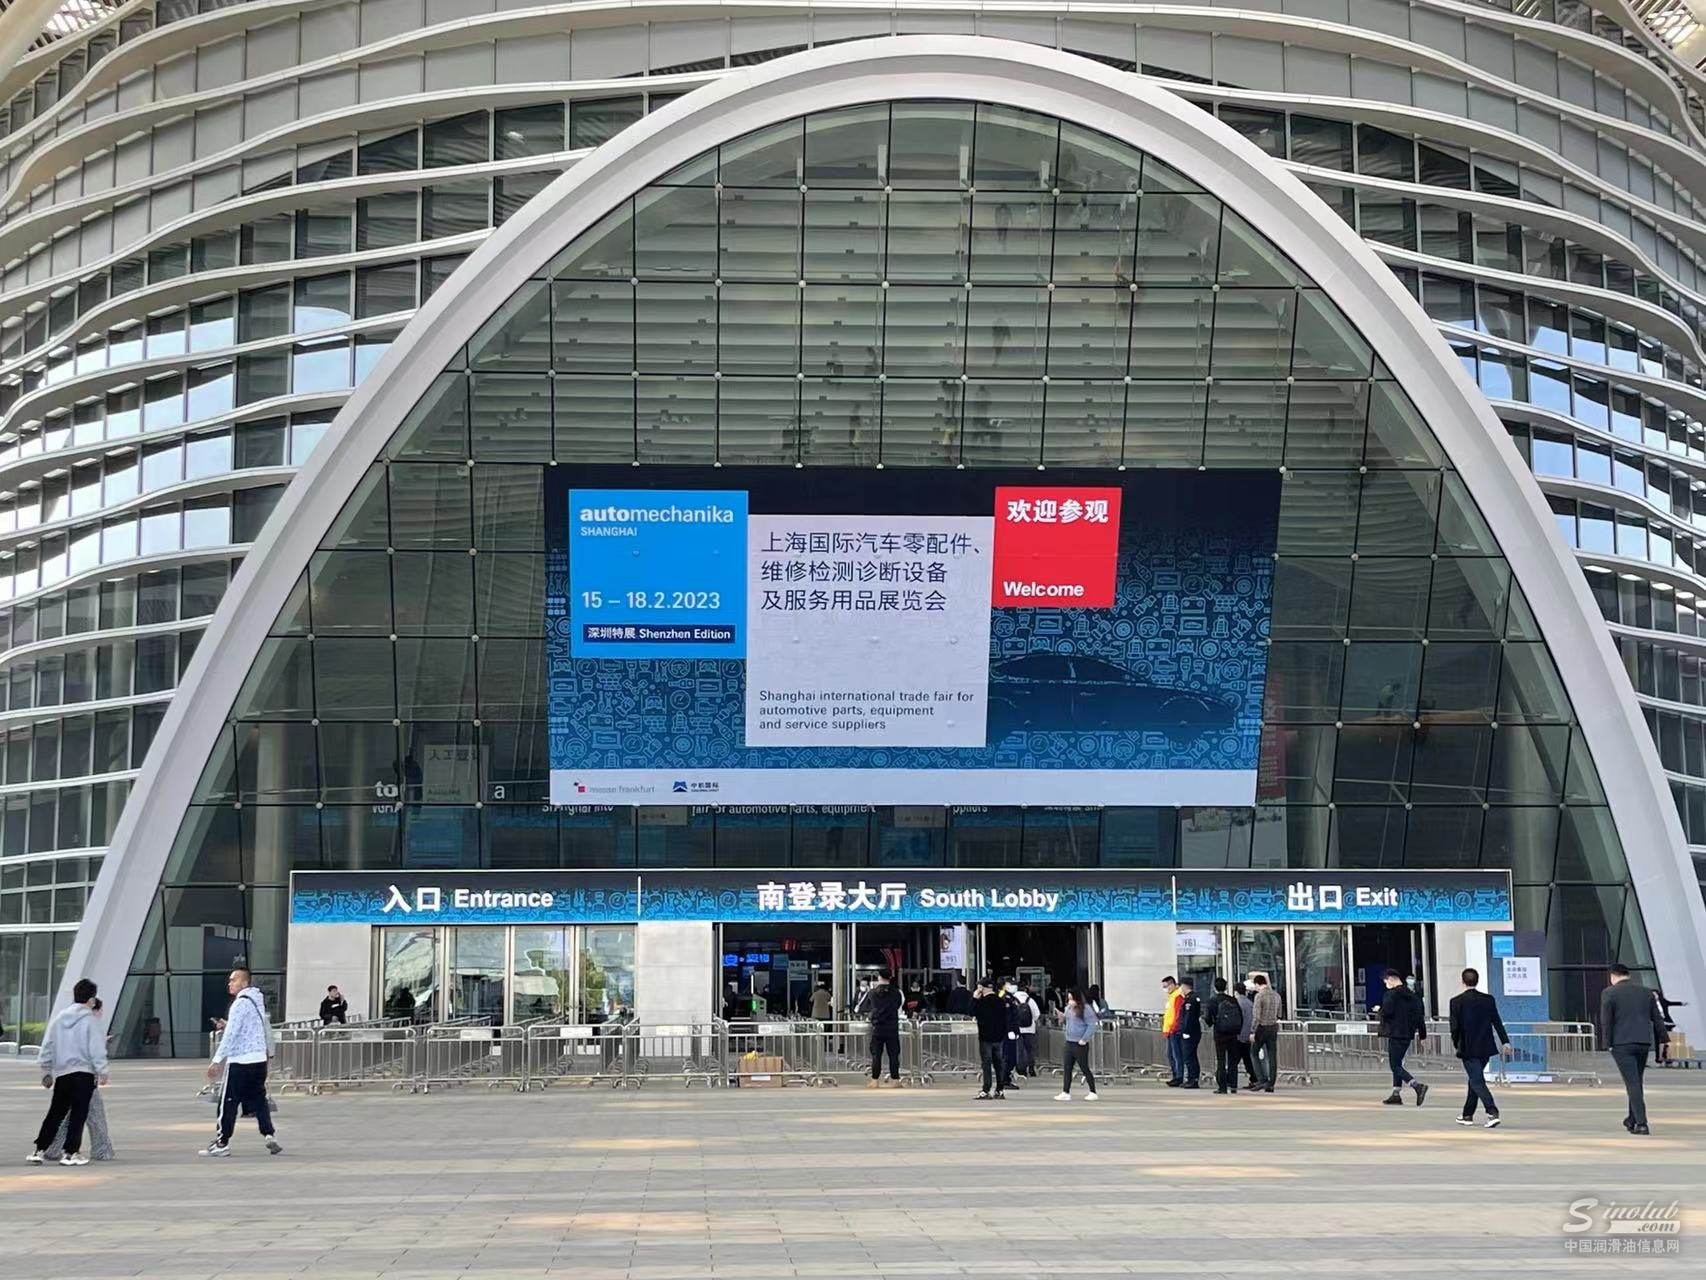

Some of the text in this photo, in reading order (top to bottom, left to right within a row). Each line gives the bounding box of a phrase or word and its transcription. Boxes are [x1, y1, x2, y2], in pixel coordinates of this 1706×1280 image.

[579, 505, 734, 523] automechanika
[1006, 499, 1109, 523] 欢迎参观
[580, 526, 638, 537] SHANGHAI
[761, 532, 984, 555] 上海国际汽车零配件、
[760, 561, 948, 584] 维修检测诊断设备
[1003, 581, 1085, 598] Welcome
[581, 591, 603, 608] 15
[626, 591, 721, 609] 18.2.2023
[760, 590, 947, 612] 及服务用品展览会
[587, 627, 731, 639] 深圳特展 Shenzhen Edition
[759, 690, 975, 703] Shanghai international trade fair for
[759, 706, 934, 718] automotive parts, equipment
[759, 718, 886, 731] and service suppliers
[382, 884, 554, 913] 入口 Entrance
[756, 881, 1059, 911] 南登录大厅 South Lobby
[1287, 881, 1399, 912] 出口 Exit
